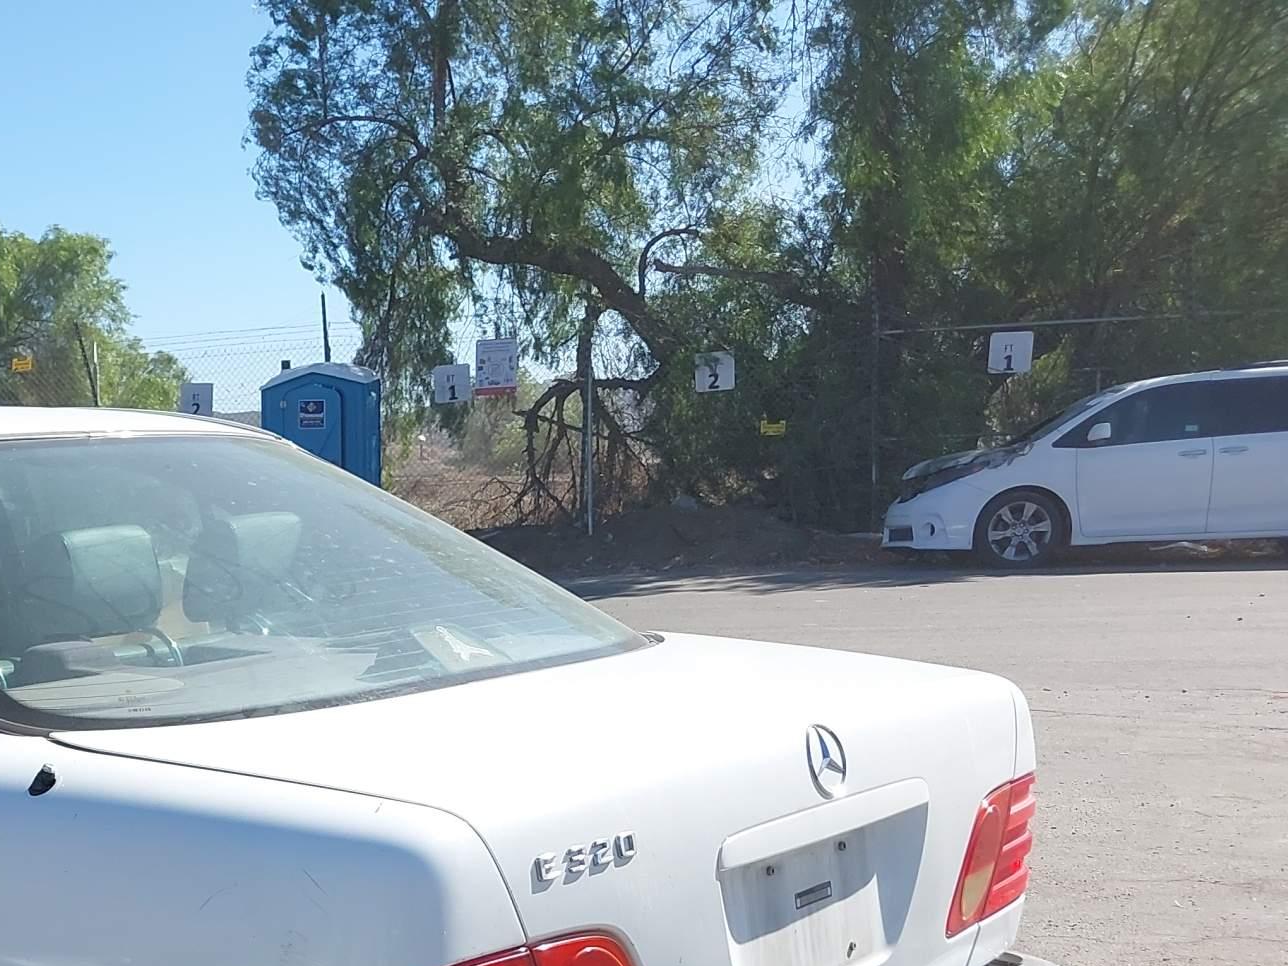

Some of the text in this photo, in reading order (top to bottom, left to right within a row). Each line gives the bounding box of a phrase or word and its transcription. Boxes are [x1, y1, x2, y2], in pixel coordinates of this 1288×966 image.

[1003, 354, 1014, 371] 1
[708, 373, 720, 389] 2
[448, 384, 458, 400] 1
